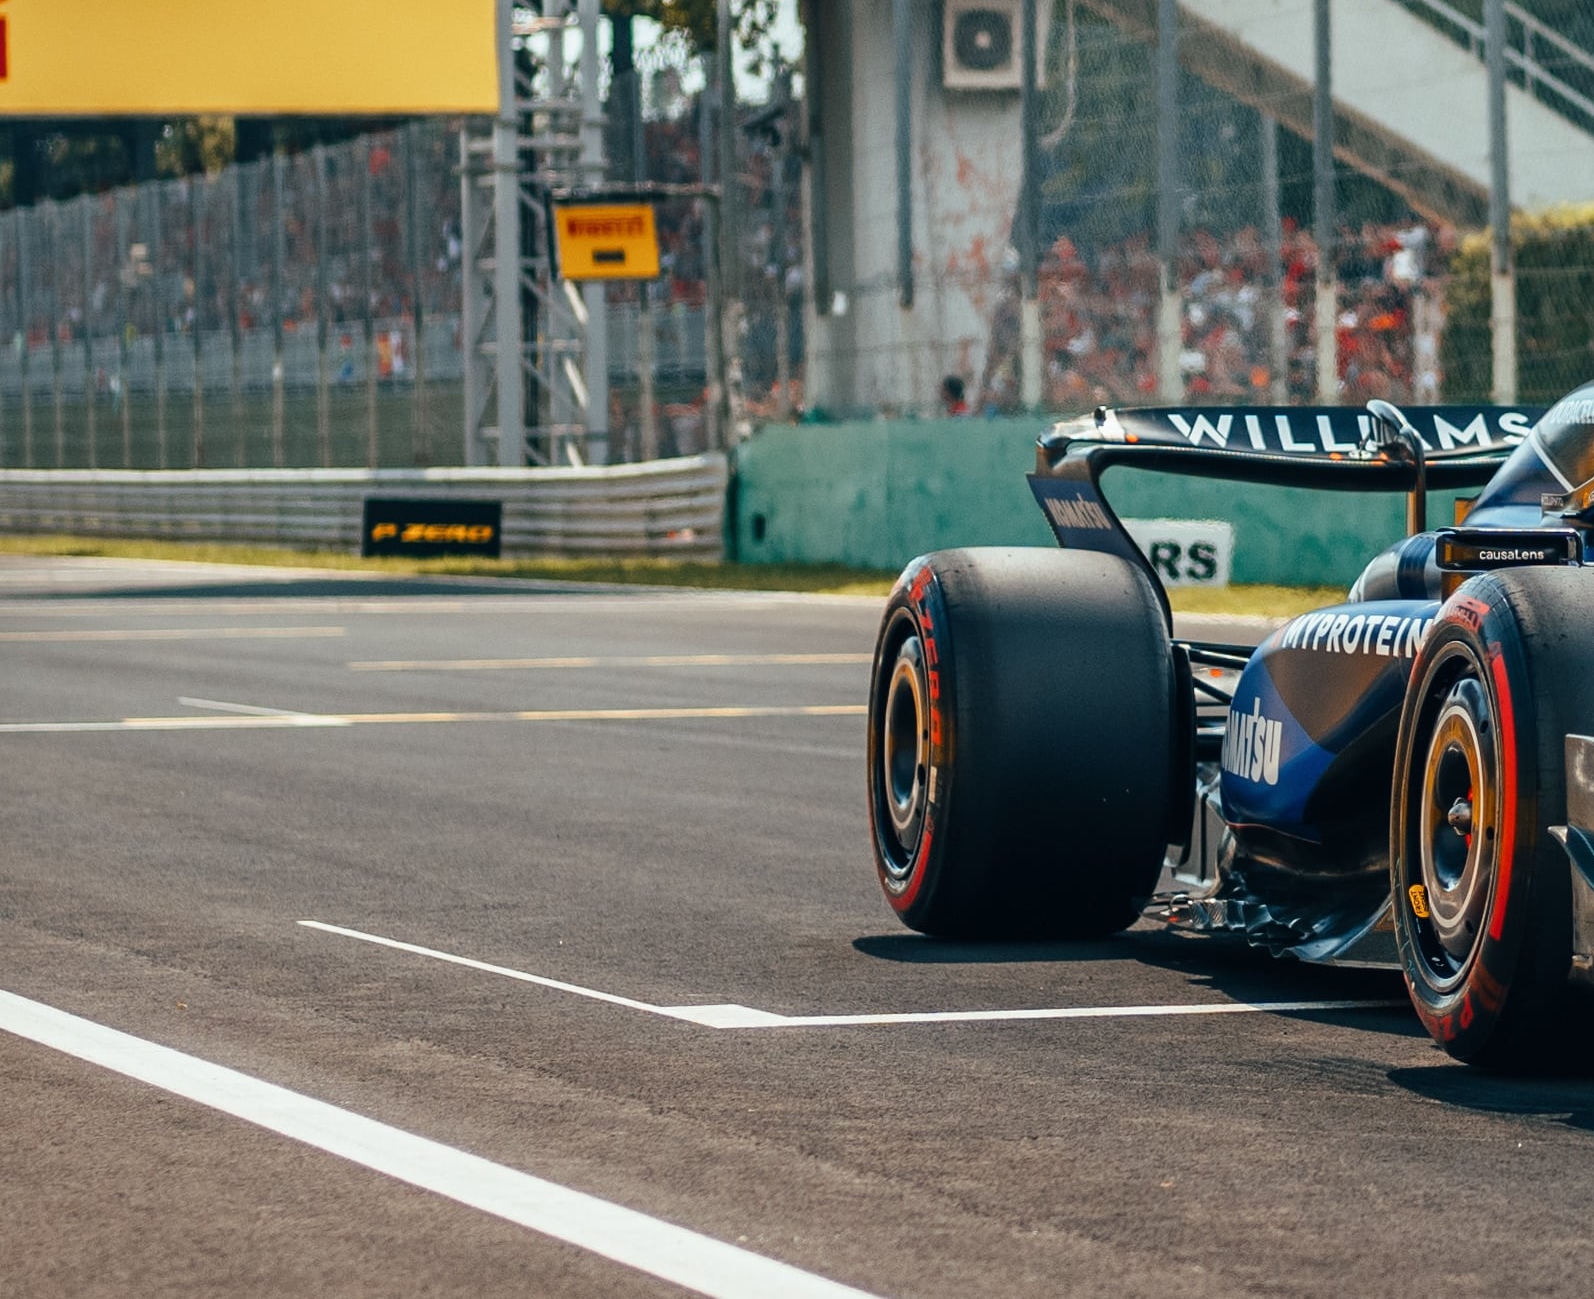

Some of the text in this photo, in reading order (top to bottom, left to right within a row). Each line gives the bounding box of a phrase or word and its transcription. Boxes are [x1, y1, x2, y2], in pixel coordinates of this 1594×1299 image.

[1168, 410, 1528, 453] WILLIMS
[1479, 549, 1545, 560] causaLens
[1282, 613, 1433, 658] MYPROTEIN
